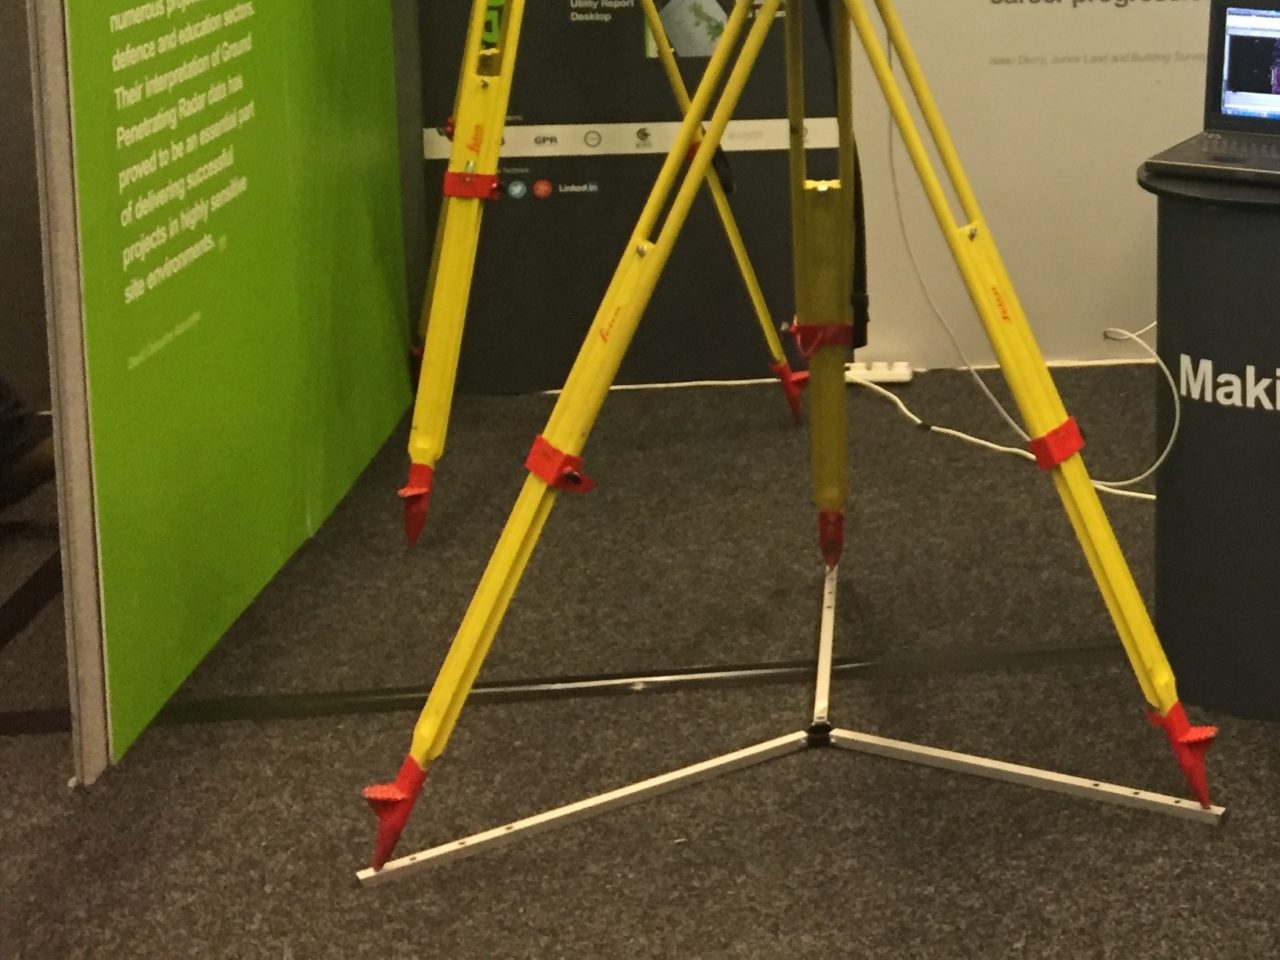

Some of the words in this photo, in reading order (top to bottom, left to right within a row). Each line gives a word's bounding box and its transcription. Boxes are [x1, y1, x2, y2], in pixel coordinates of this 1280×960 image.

[110, 0, 164, 33] numerous
[571, 12, 612, 22] Desktop
[112, 41, 156, 72] defence
[157, 28, 177, 54] and
[114, 80, 143, 111] Their
[221, 31, 252, 62] Ground
[116, 106, 178, 150] Penetrating
[178, 92, 206, 119] Radar
[534, 136, 558, 145] GPR
[119, 150, 157, 194] proved
[158, 148, 170, 168] to
[171, 141, 184, 162] be
[121, 200, 132, 227] of
[123, 226, 167, 272] projects
[124, 278, 145, 304] site
